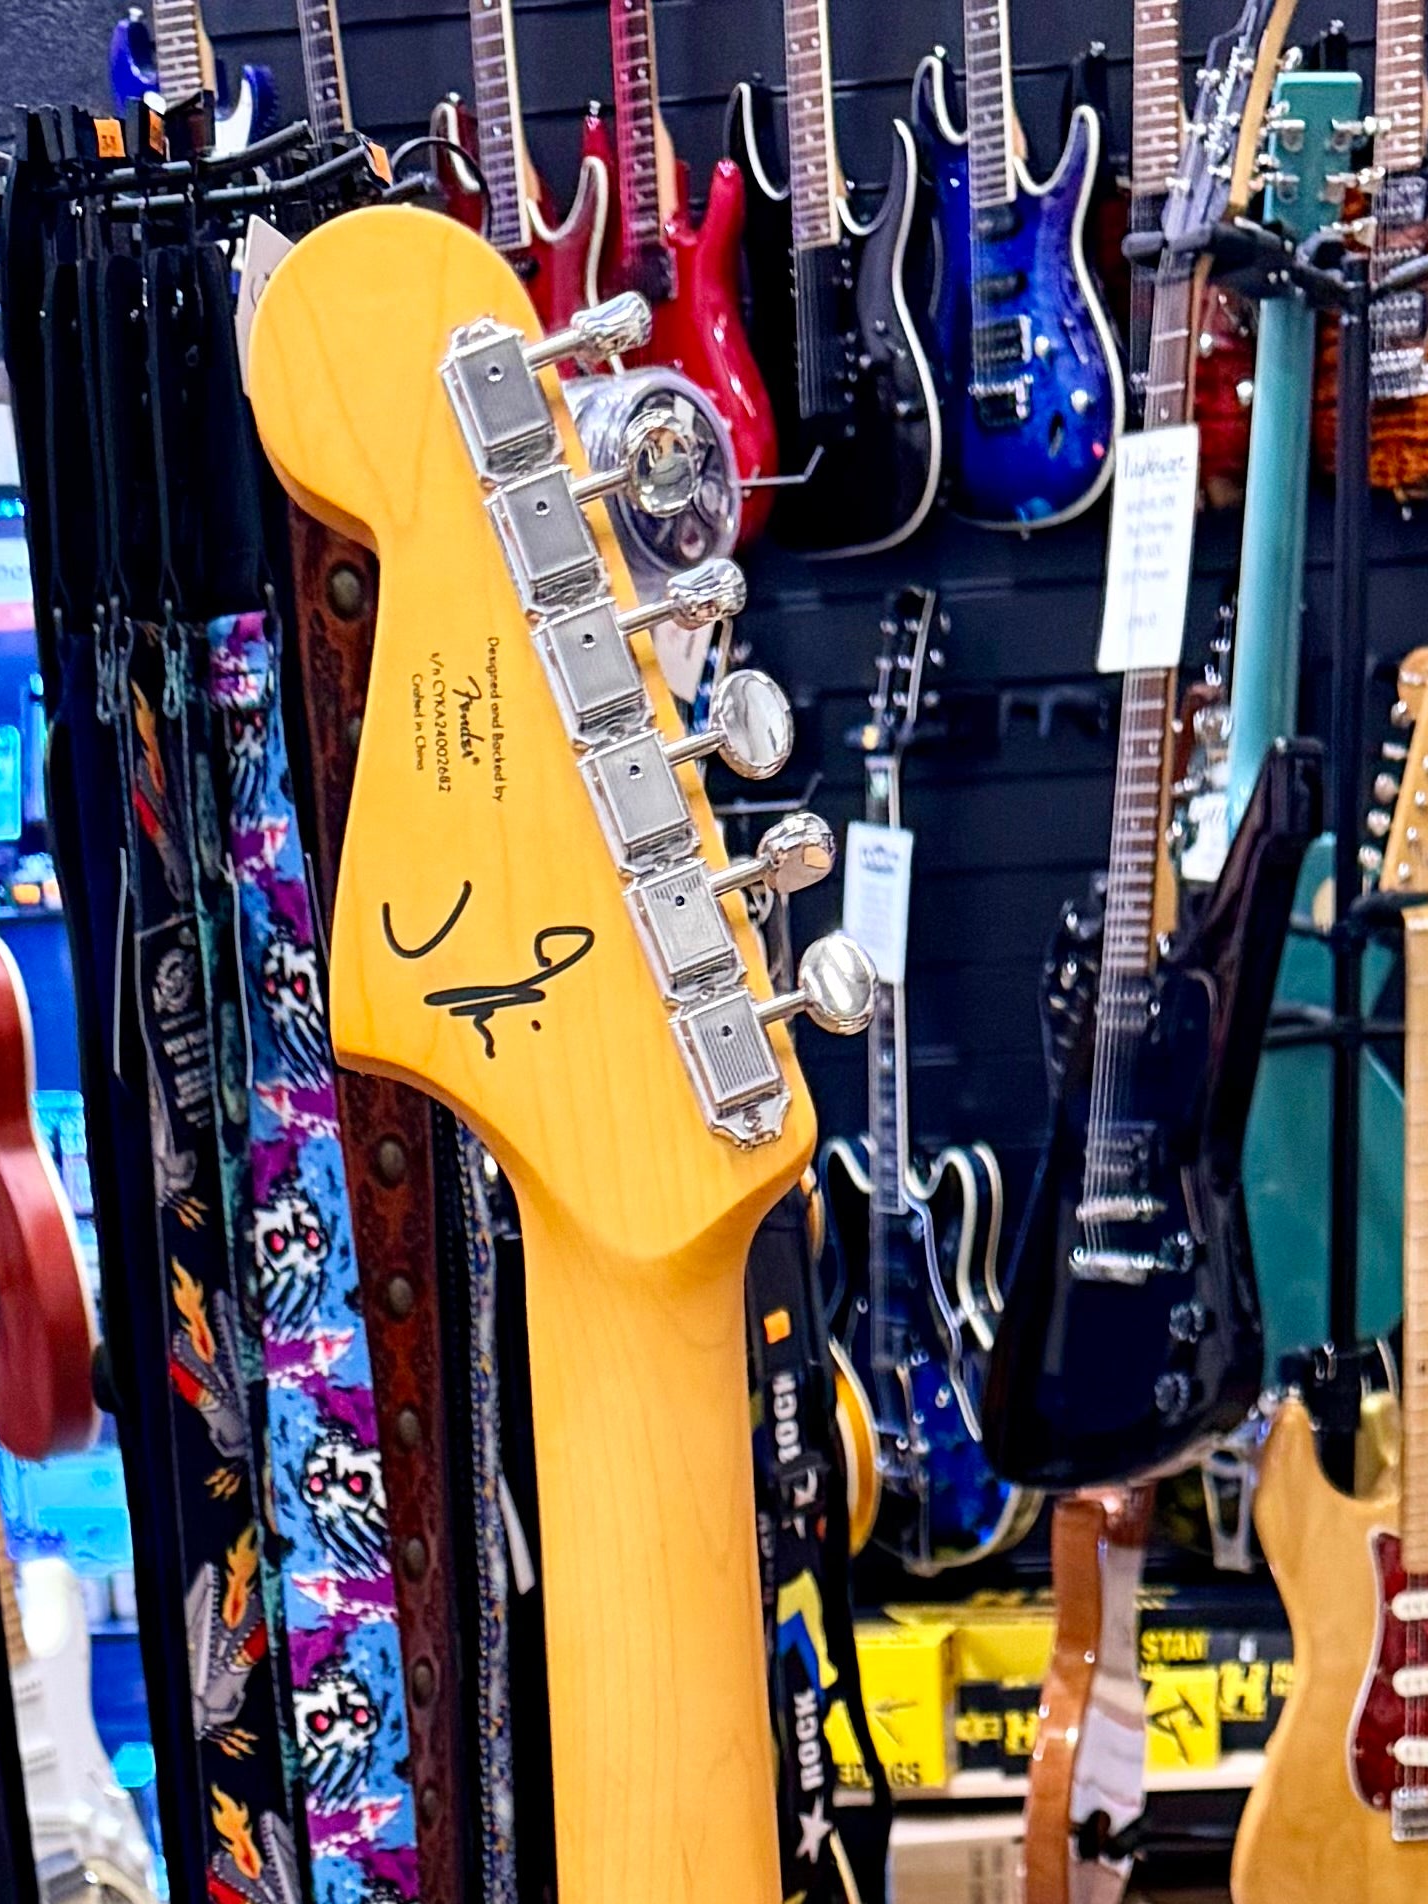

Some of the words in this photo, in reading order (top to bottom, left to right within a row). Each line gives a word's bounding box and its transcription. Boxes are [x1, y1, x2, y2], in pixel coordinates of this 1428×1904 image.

[484, 636, 503, 699] Designed
[411, 673, 427, 719] Crafted
[490, 703, 505, 729] and
[414, 721, 423, 732] in
[415, 735, 427, 771] China
[491, 733, 506, 782] Backed
[492, 786, 508, 803] by
[793, 1687, 825, 1792] ROCK
